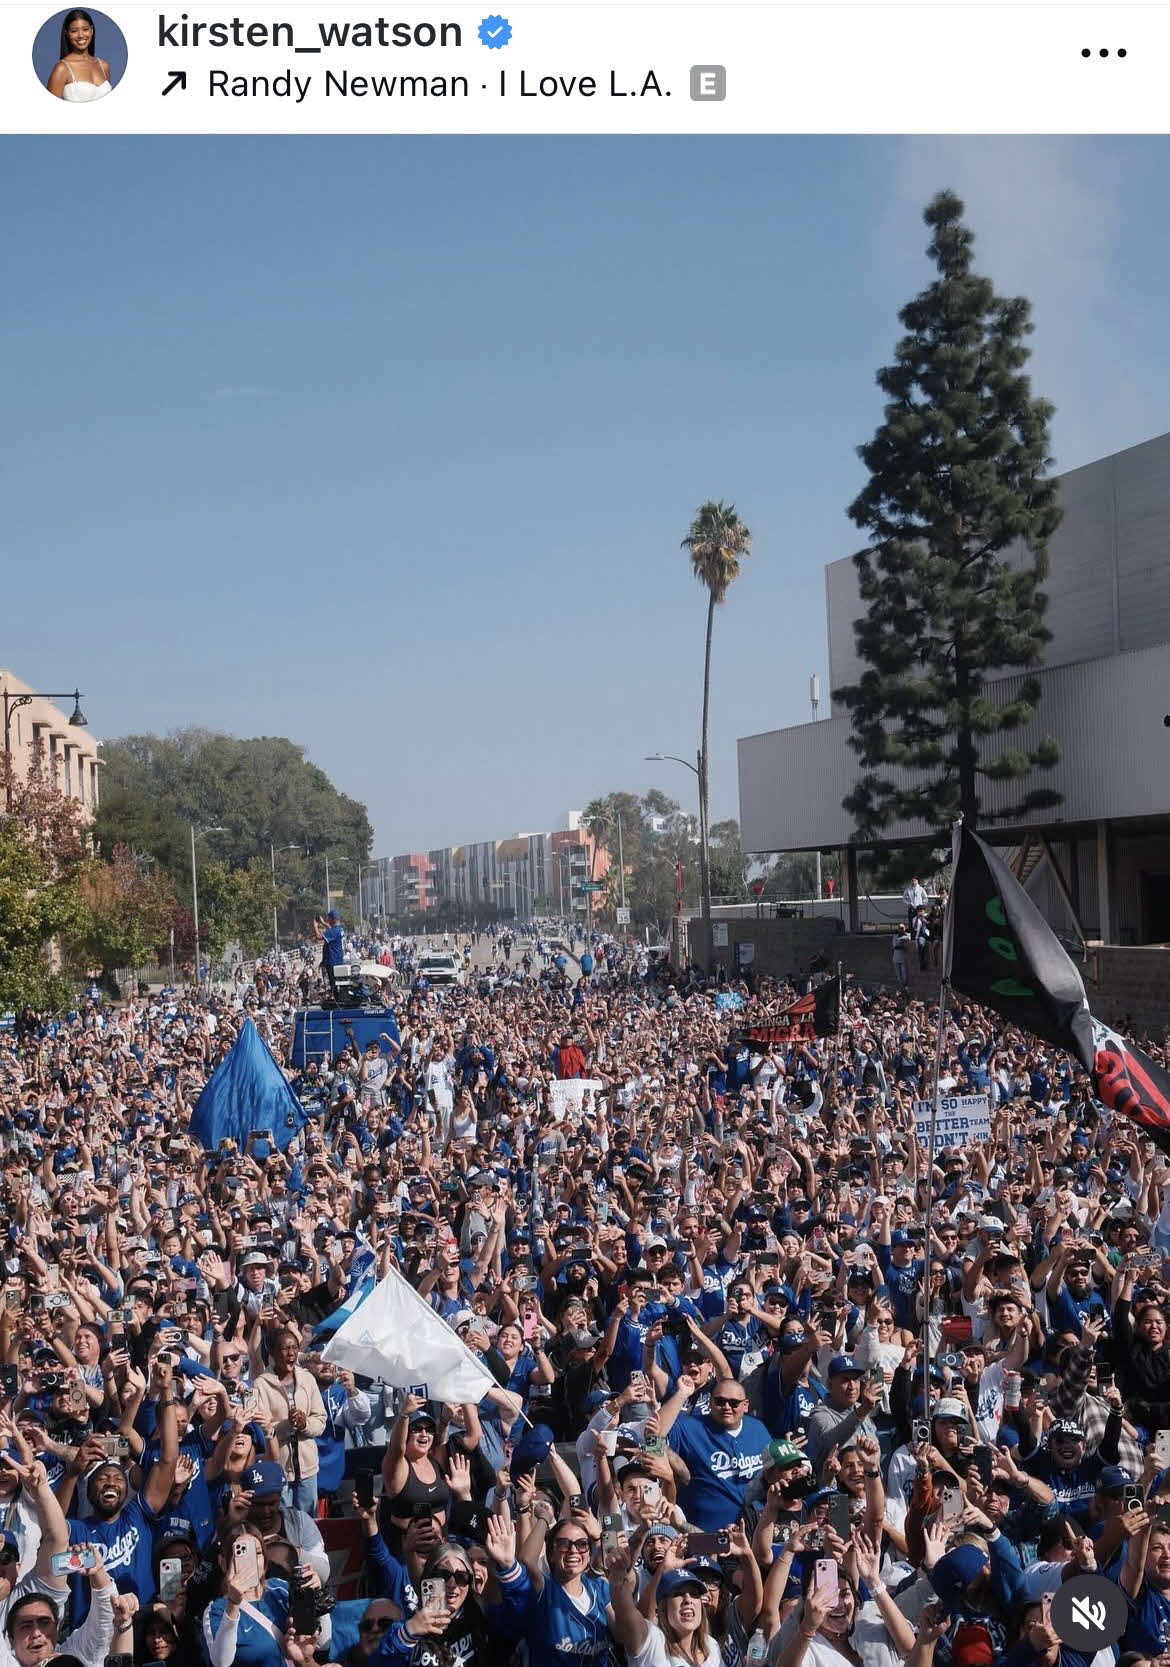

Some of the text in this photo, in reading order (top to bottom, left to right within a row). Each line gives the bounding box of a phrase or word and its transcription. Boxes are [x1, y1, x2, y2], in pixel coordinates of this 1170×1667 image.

[801, 1012, 815, 1023] LA
[941, 1098, 957, 1110] SO
[962, 1097, 987, 1106] HAPPY
[916, 1117, 989, 1133] BETTER TEAM
[917, 1132, 968, 1148] DDN'T
[845, 1356, 854, 1367] LA
[711, 1450, 763, 1479] Dodger
[252, 1469, 263, 1484] LA
[92, 1526, 140, 1569] Dodge
[699, 1556, 710, 1567] LA
